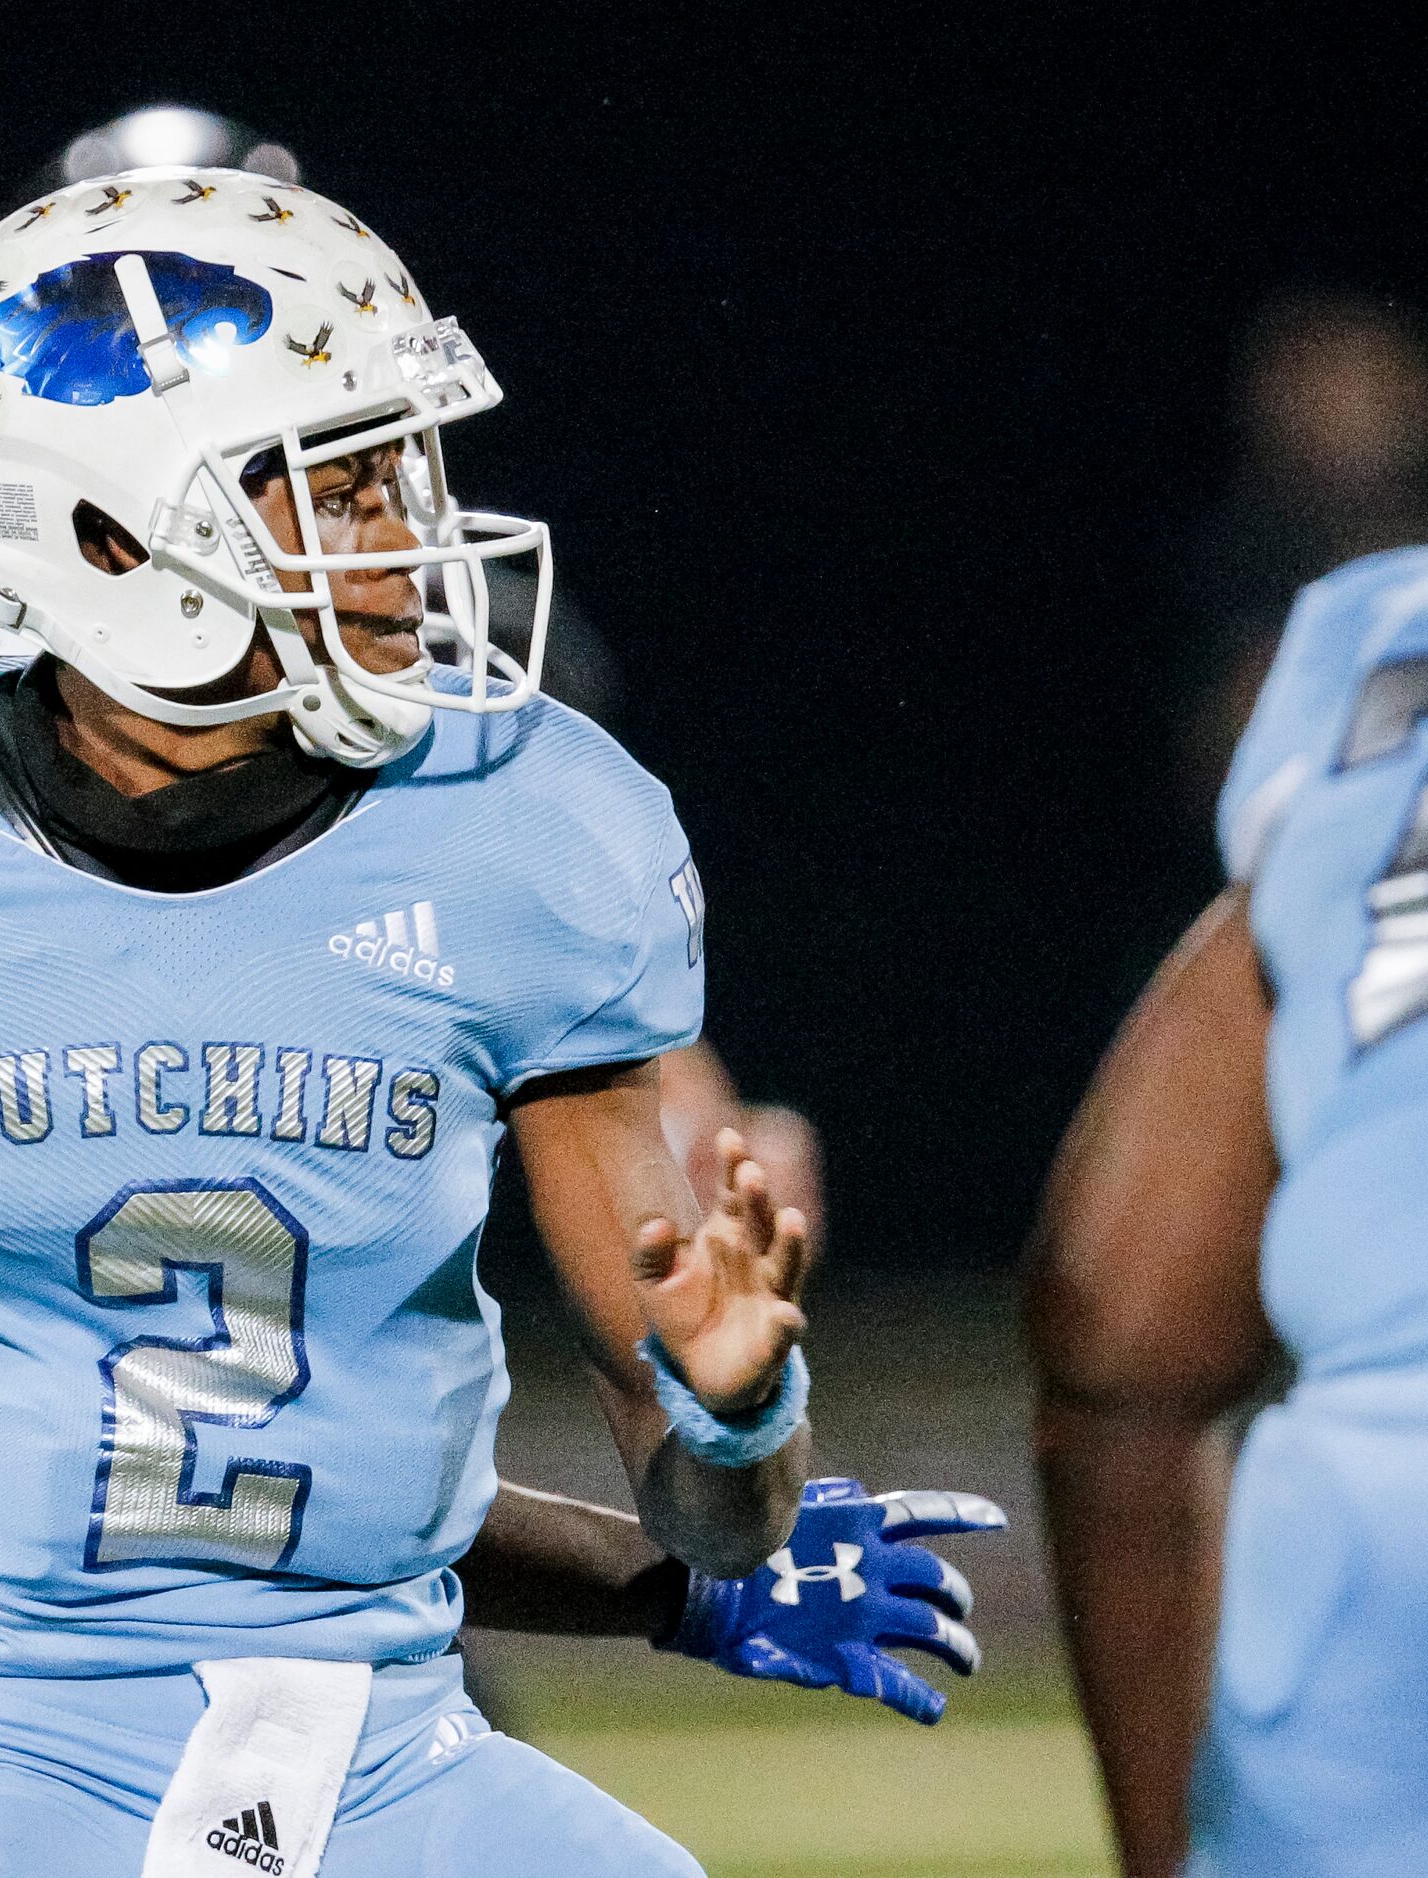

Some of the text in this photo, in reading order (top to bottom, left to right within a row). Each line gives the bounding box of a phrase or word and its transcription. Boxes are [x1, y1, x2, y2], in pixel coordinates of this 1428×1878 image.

[329, 934, 455, 987] adidas
[74, 1175, 313, 1573] 2
[206, 1829, 284, 1877] adidas
